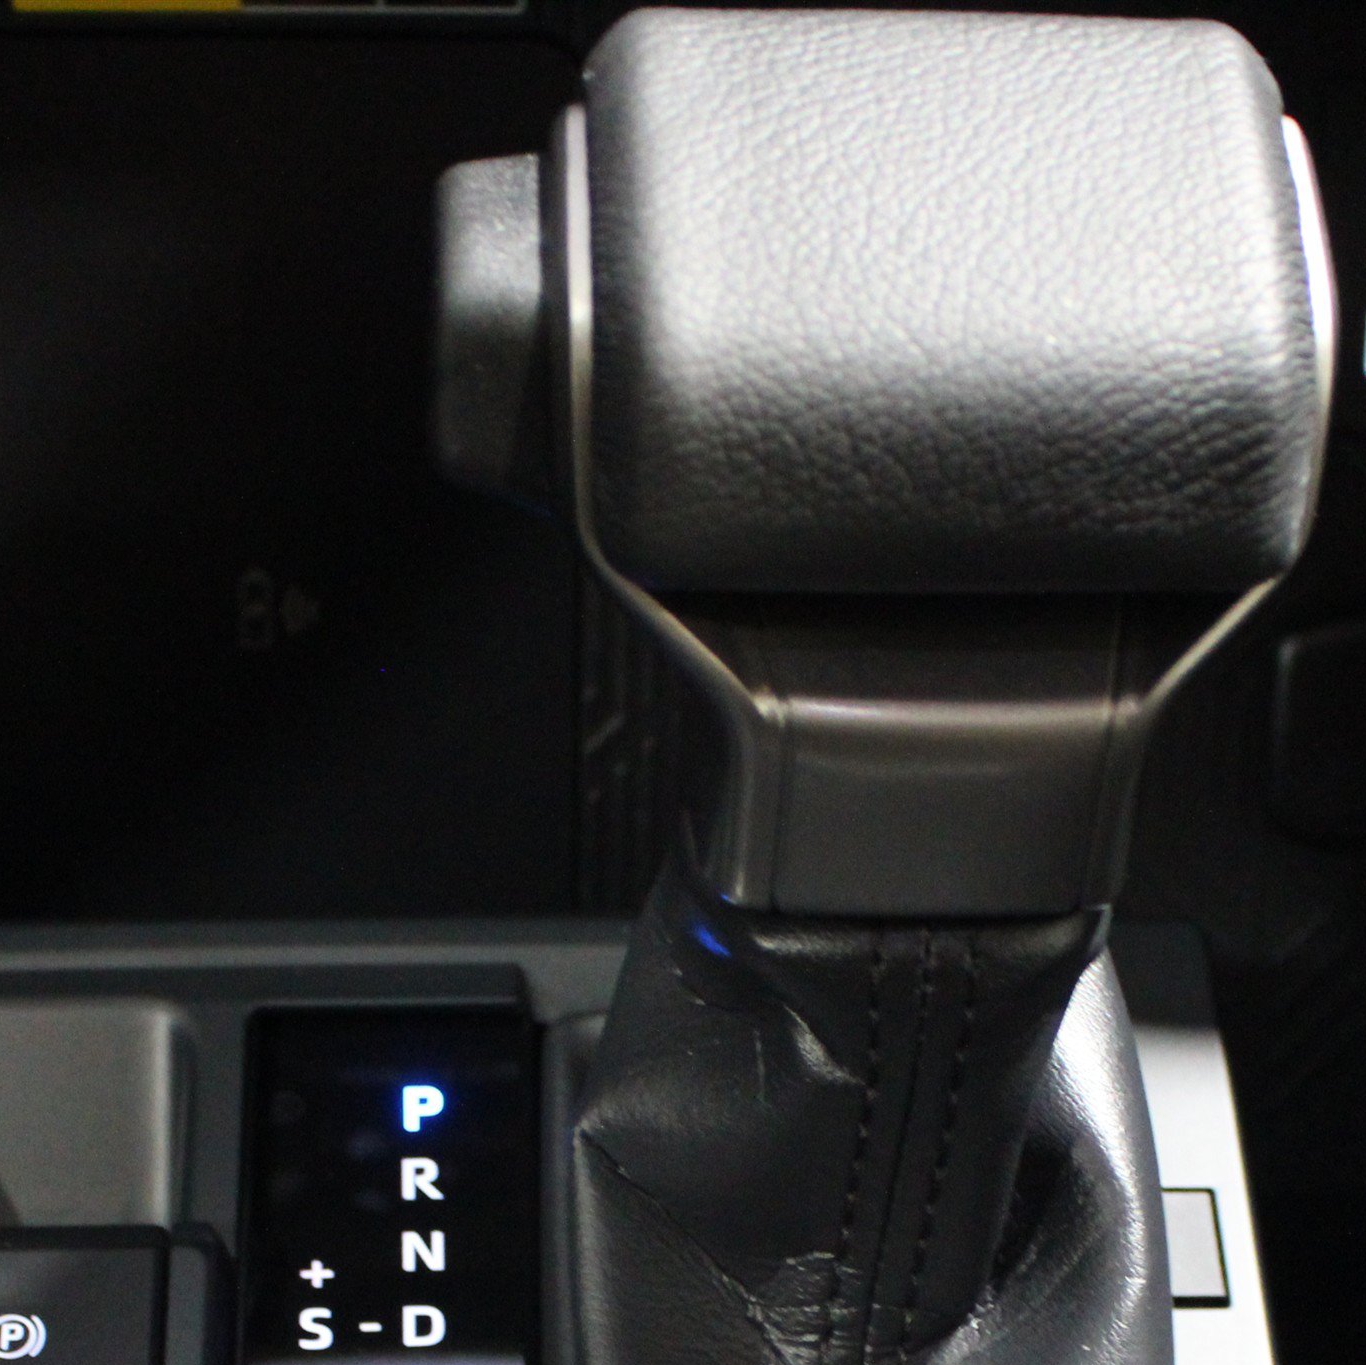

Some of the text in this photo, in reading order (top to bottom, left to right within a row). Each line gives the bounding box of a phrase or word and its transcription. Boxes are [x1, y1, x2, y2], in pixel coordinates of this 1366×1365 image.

[402, 1085, 445, 1132] P
[400, 1157, 445, 1200] R
[401, 1230, 446, 1272] N
[298, 1307, 334, 1351] S
[401, 1305, 446, 1348] D
